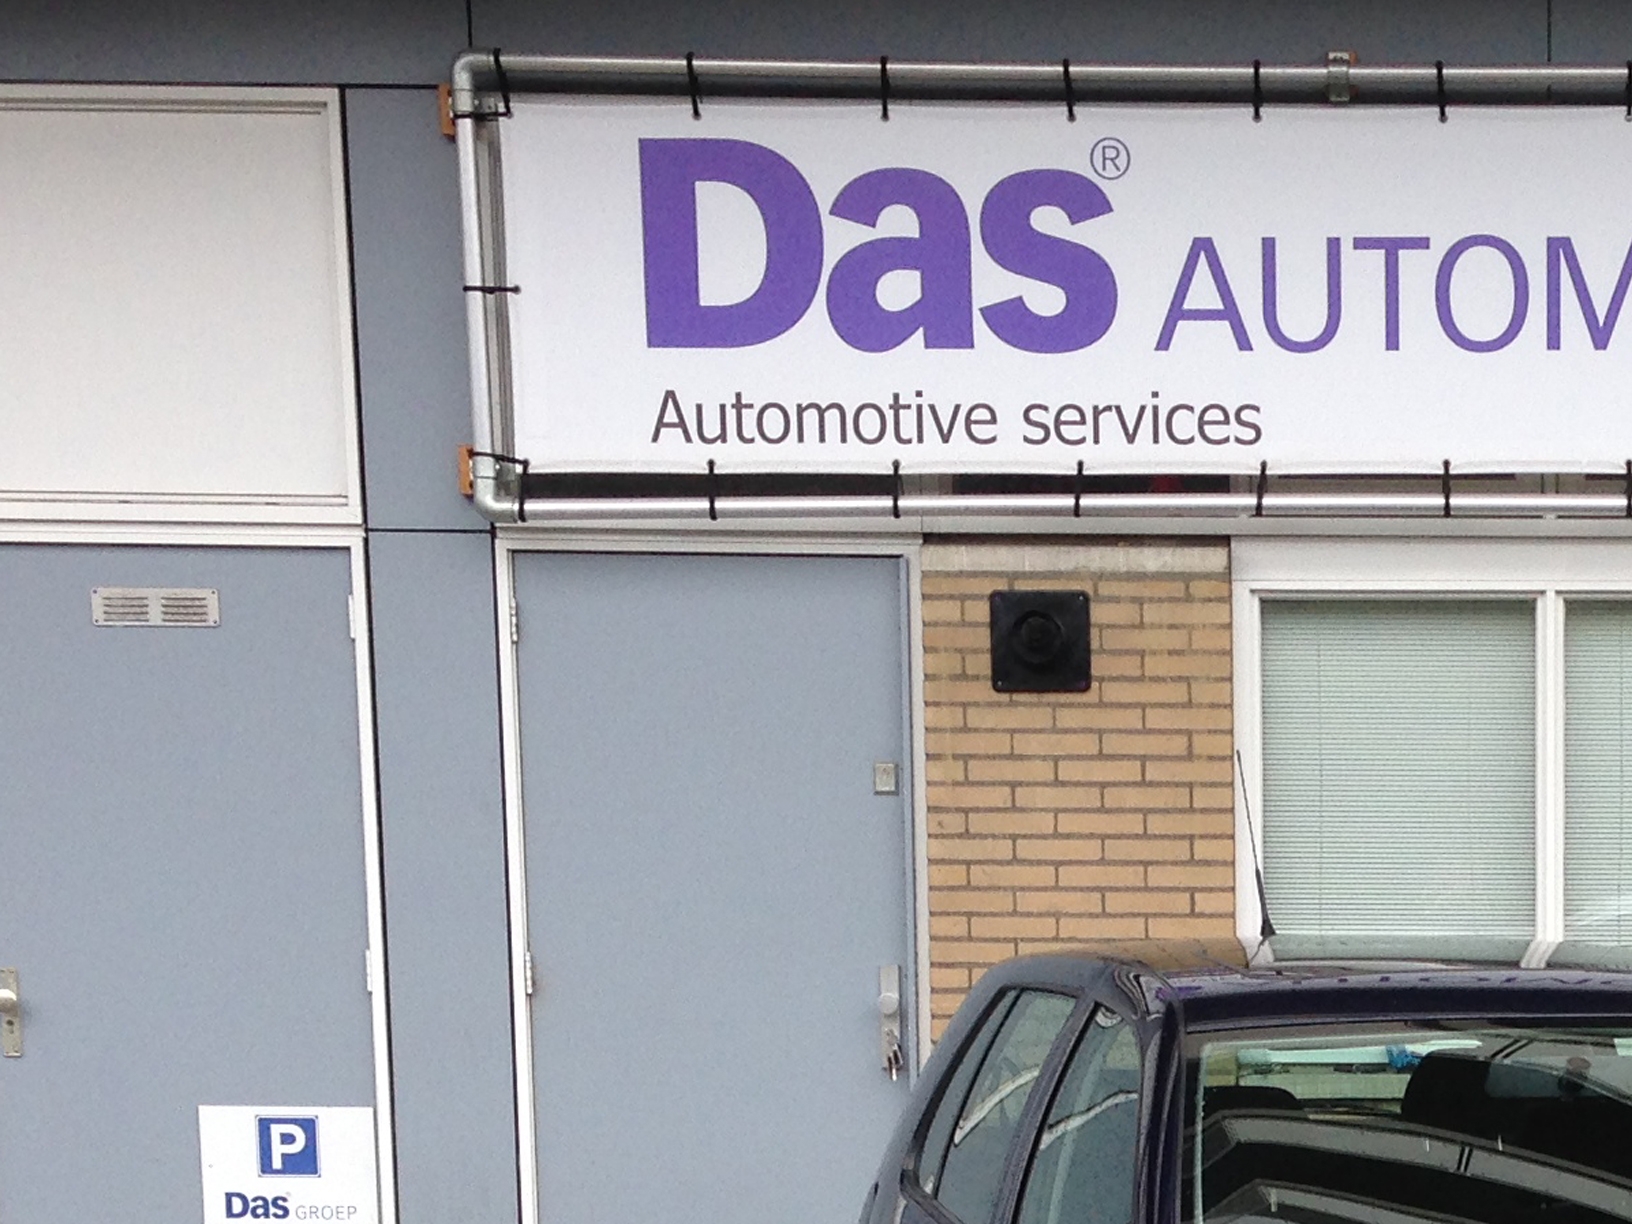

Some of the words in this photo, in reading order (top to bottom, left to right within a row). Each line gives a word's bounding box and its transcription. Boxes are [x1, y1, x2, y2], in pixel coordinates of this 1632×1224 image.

[651, 389, 998, 446] Automotive
[1021, 390, 1263, 447] services
[224, 1191, 290, 1220] Das
[294, 1204, 358, 1221] GROEP
